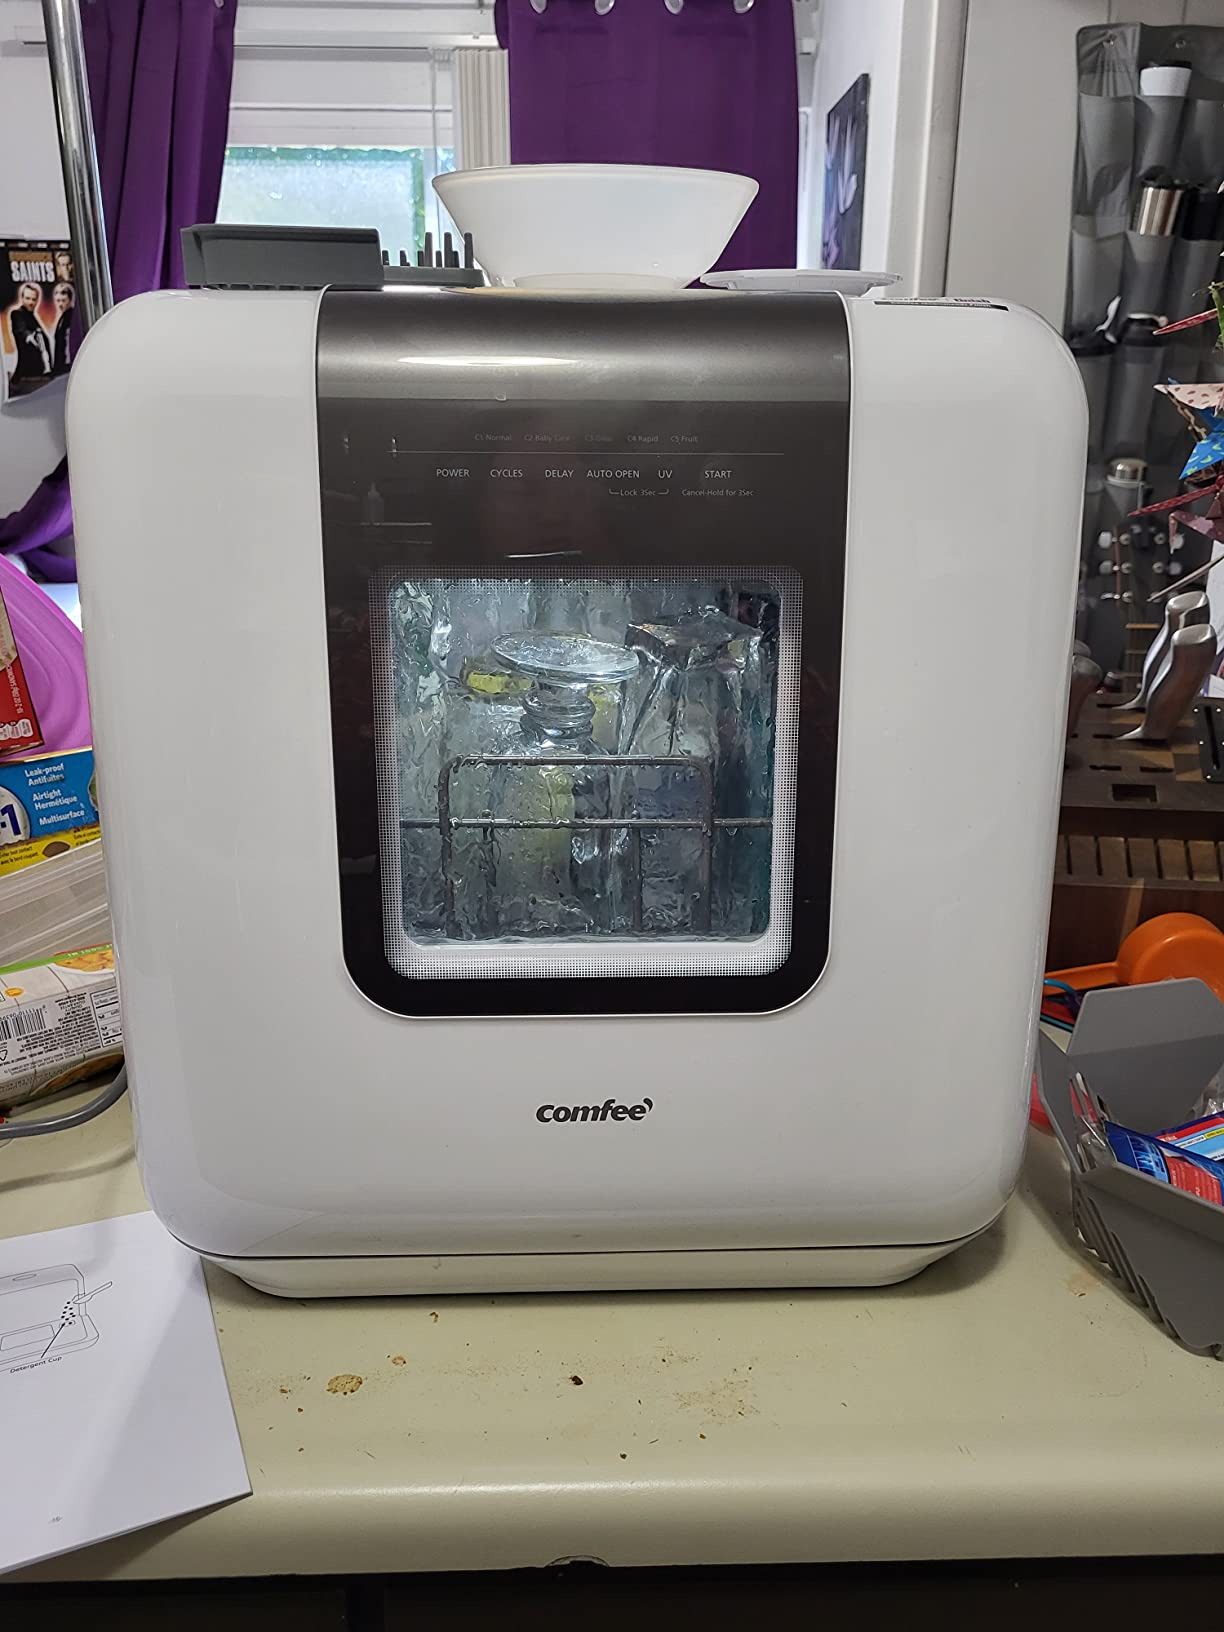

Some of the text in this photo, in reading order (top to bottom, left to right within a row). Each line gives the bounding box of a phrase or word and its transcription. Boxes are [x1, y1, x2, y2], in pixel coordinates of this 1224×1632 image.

[10, 260, 56, 282] SAINTS
[485, 433, 512, 441] Normal
[638, 433, 659, 444] Rapid
[681, 434, 699, 442] Fruit
[436, 468, 470, 478] POWER
[490, 469, 523, 478] CYCLES
[544, 469, 574, 478] DELAY
[586, 469, 640, 479] AUTO OPEN
[658, 470, 673, 479] UV
[704, 470, 732, 479] START
[620, 488, 637, 496] Lock
[725, 488, 736, 496] for
[24, 763, 64, 777] Leak-proof
[28, 773, 64, 786] Antifuites
[32, 789, 61, 801] Airtight
[34, 795, 78, 811] Hermétique
[39, 810, 85, 825] Multisurface
[10, 1360, 46, 1373] Detergent
